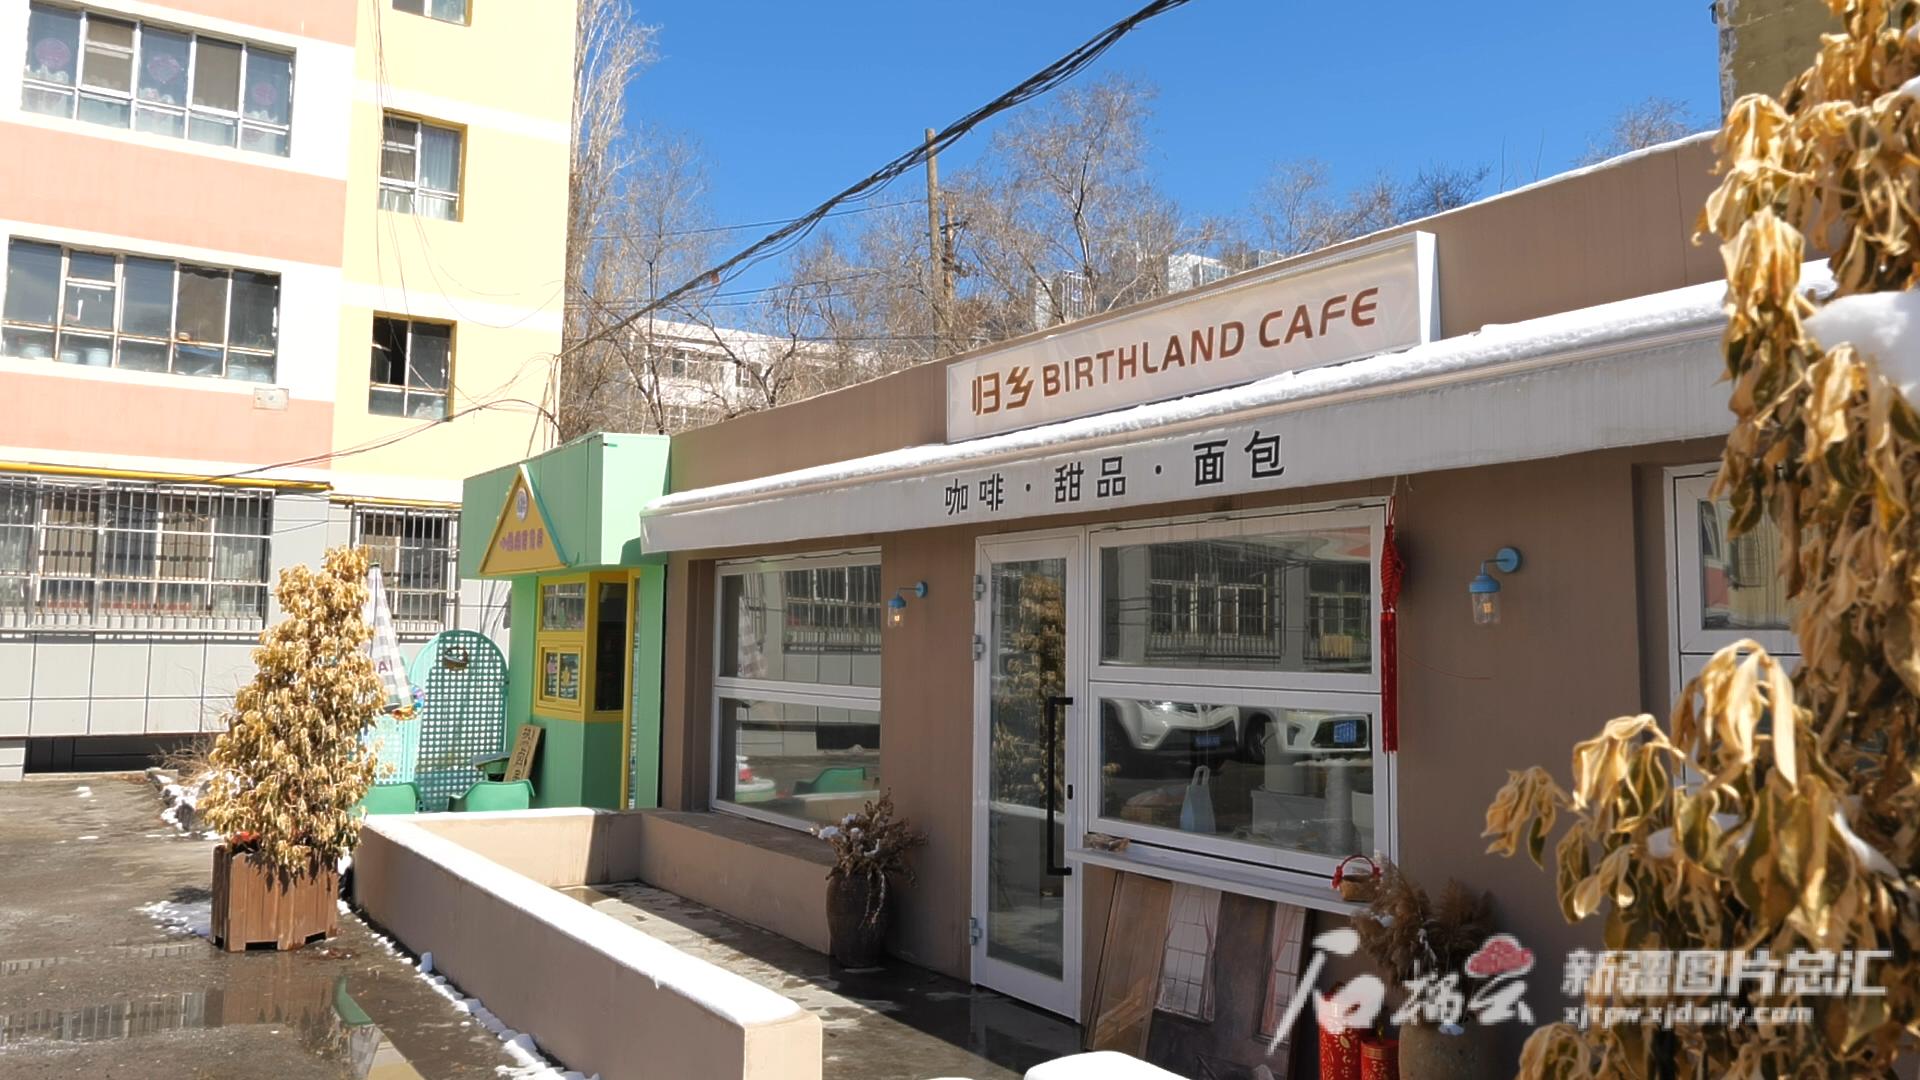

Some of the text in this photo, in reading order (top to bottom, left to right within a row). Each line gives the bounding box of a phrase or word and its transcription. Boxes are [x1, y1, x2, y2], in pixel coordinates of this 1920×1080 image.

[971, 287, 1379, 415] 归乡 BIRTHLAND CAFE
